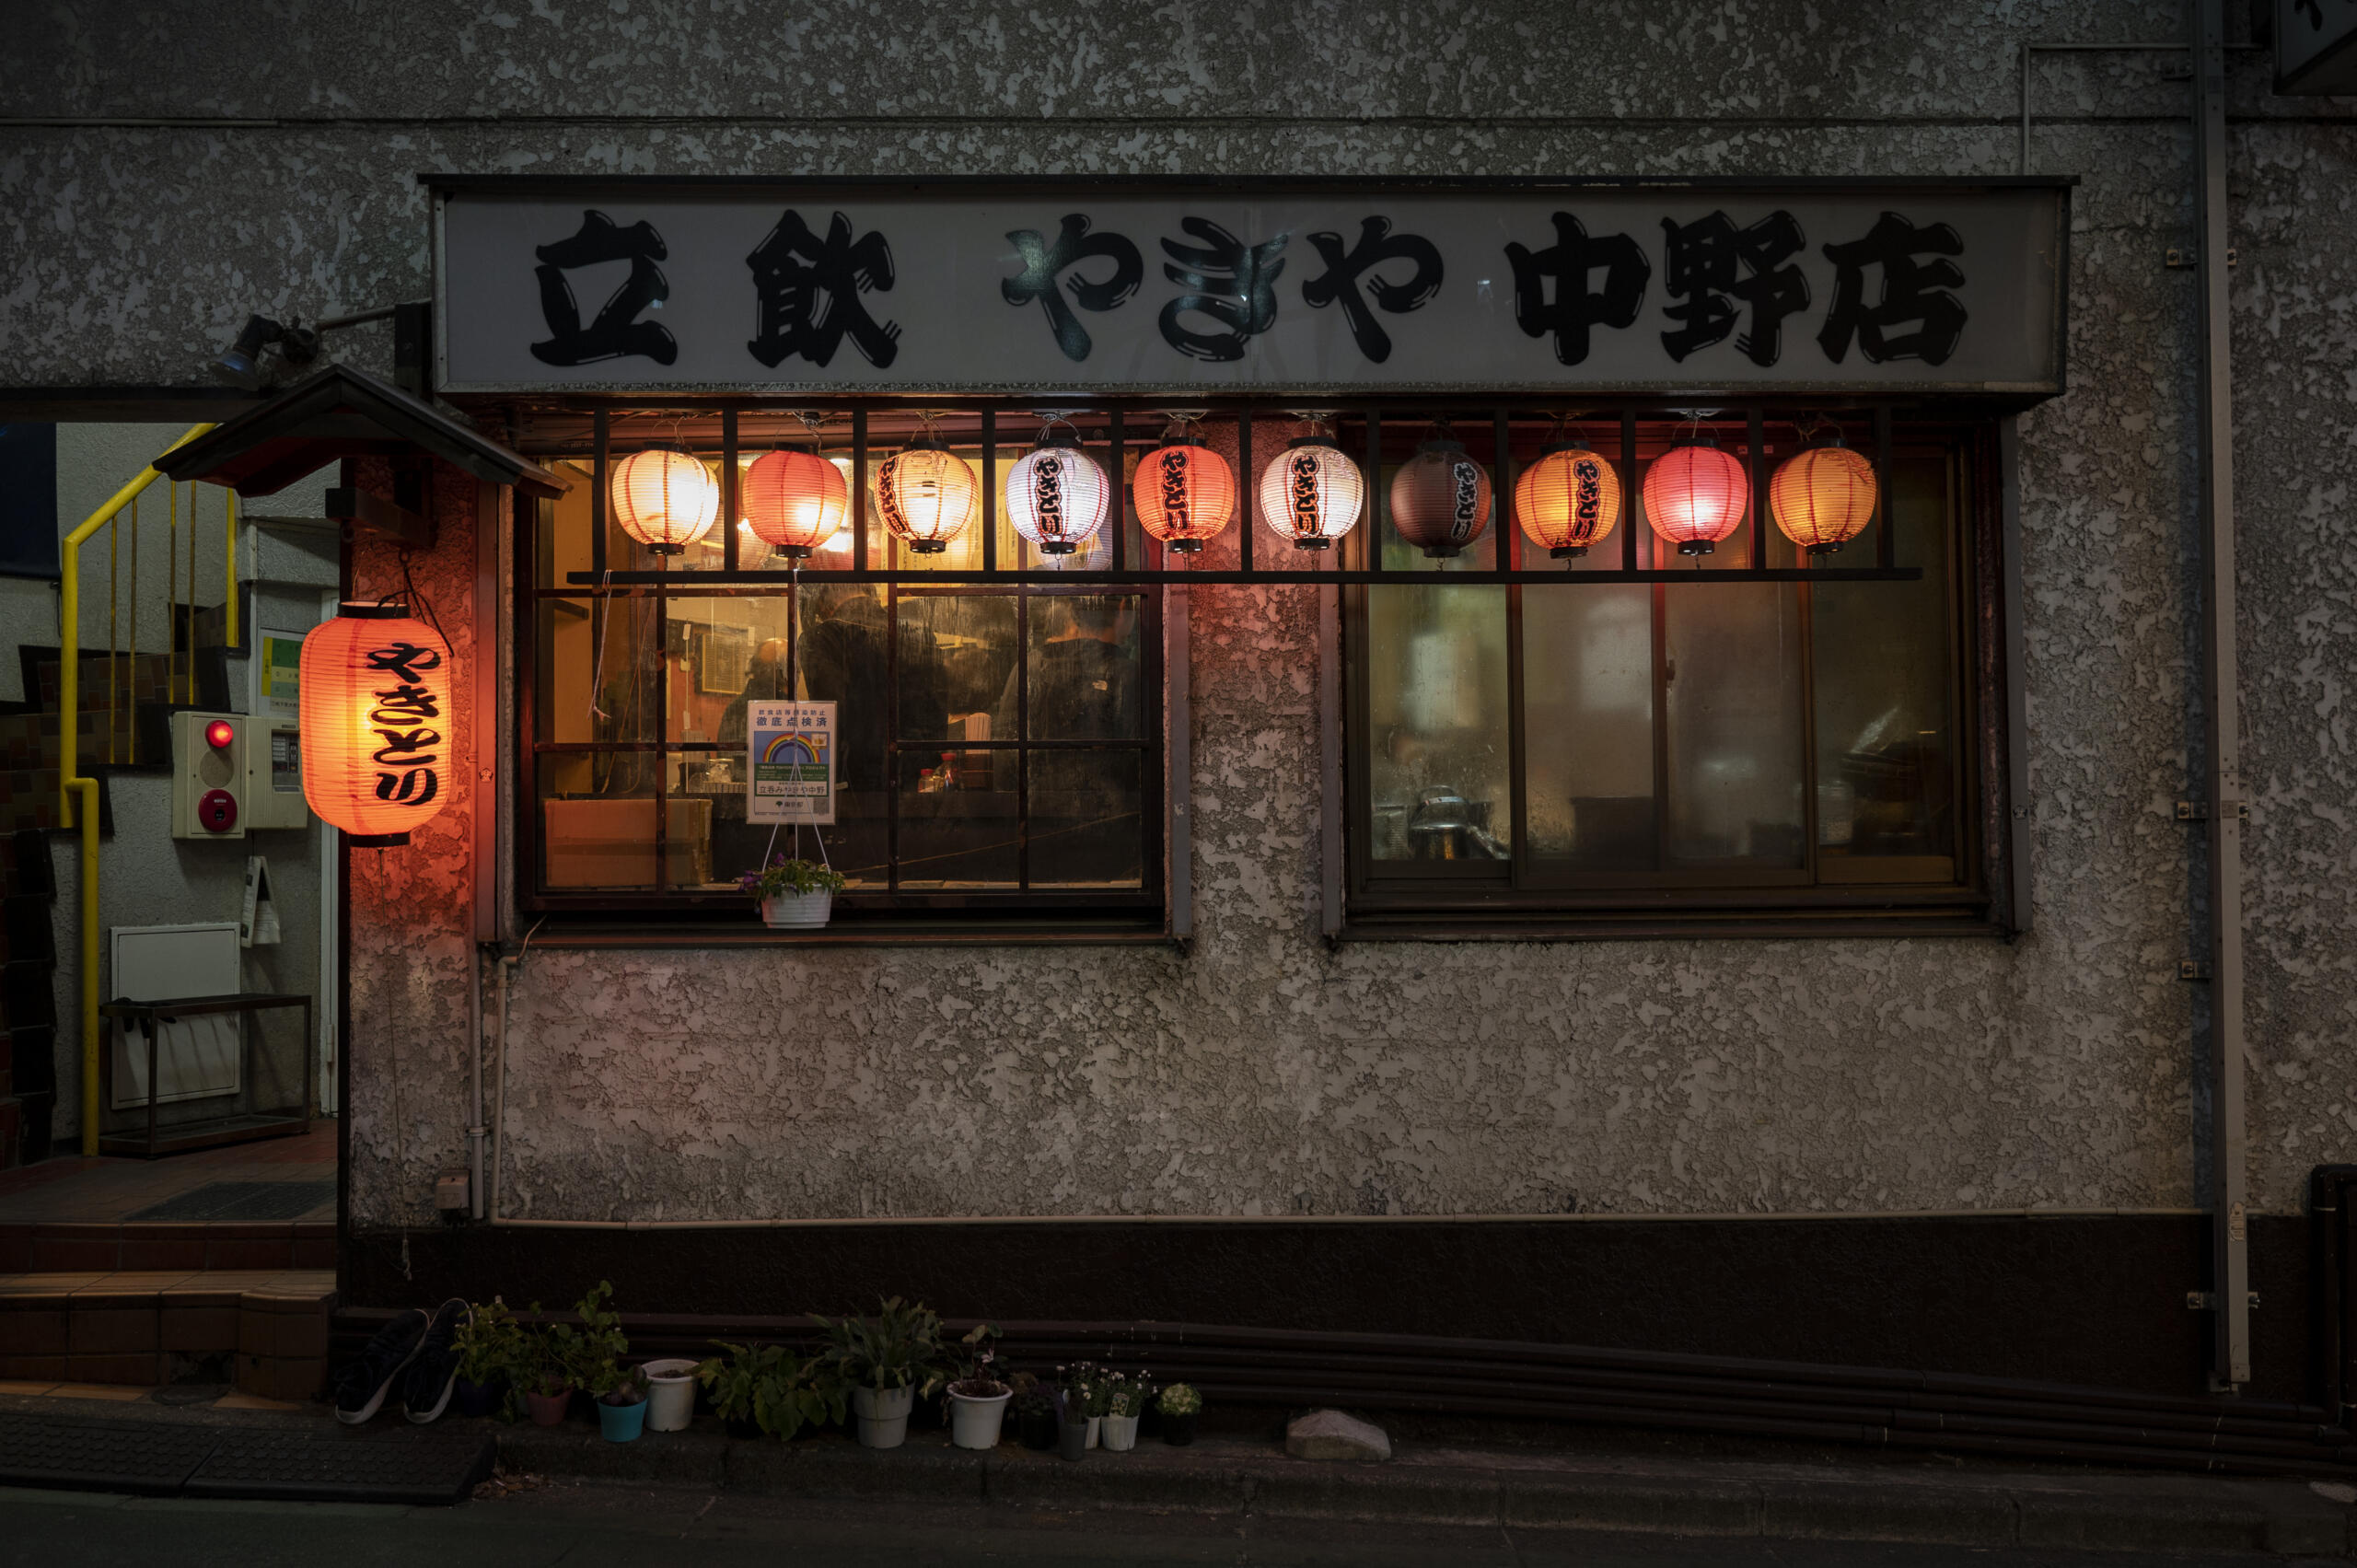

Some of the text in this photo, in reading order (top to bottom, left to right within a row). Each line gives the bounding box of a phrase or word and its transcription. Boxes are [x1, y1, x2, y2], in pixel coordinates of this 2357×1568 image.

[530, 209, 1968, 369] 立飲 やきや 中野店
[1034, 457, 1063, 534] やきとり
[1161, 450, 1190, 530] やきとり
[1292, 455, 1319, 534] やきとり
[1450, 462, 1478, 540] やきとり
[1573, 460, 1600, 539] やきとり
[366, 643, 441, 806] やきとり
[757, 716, 827, 726] 徹底点検済
